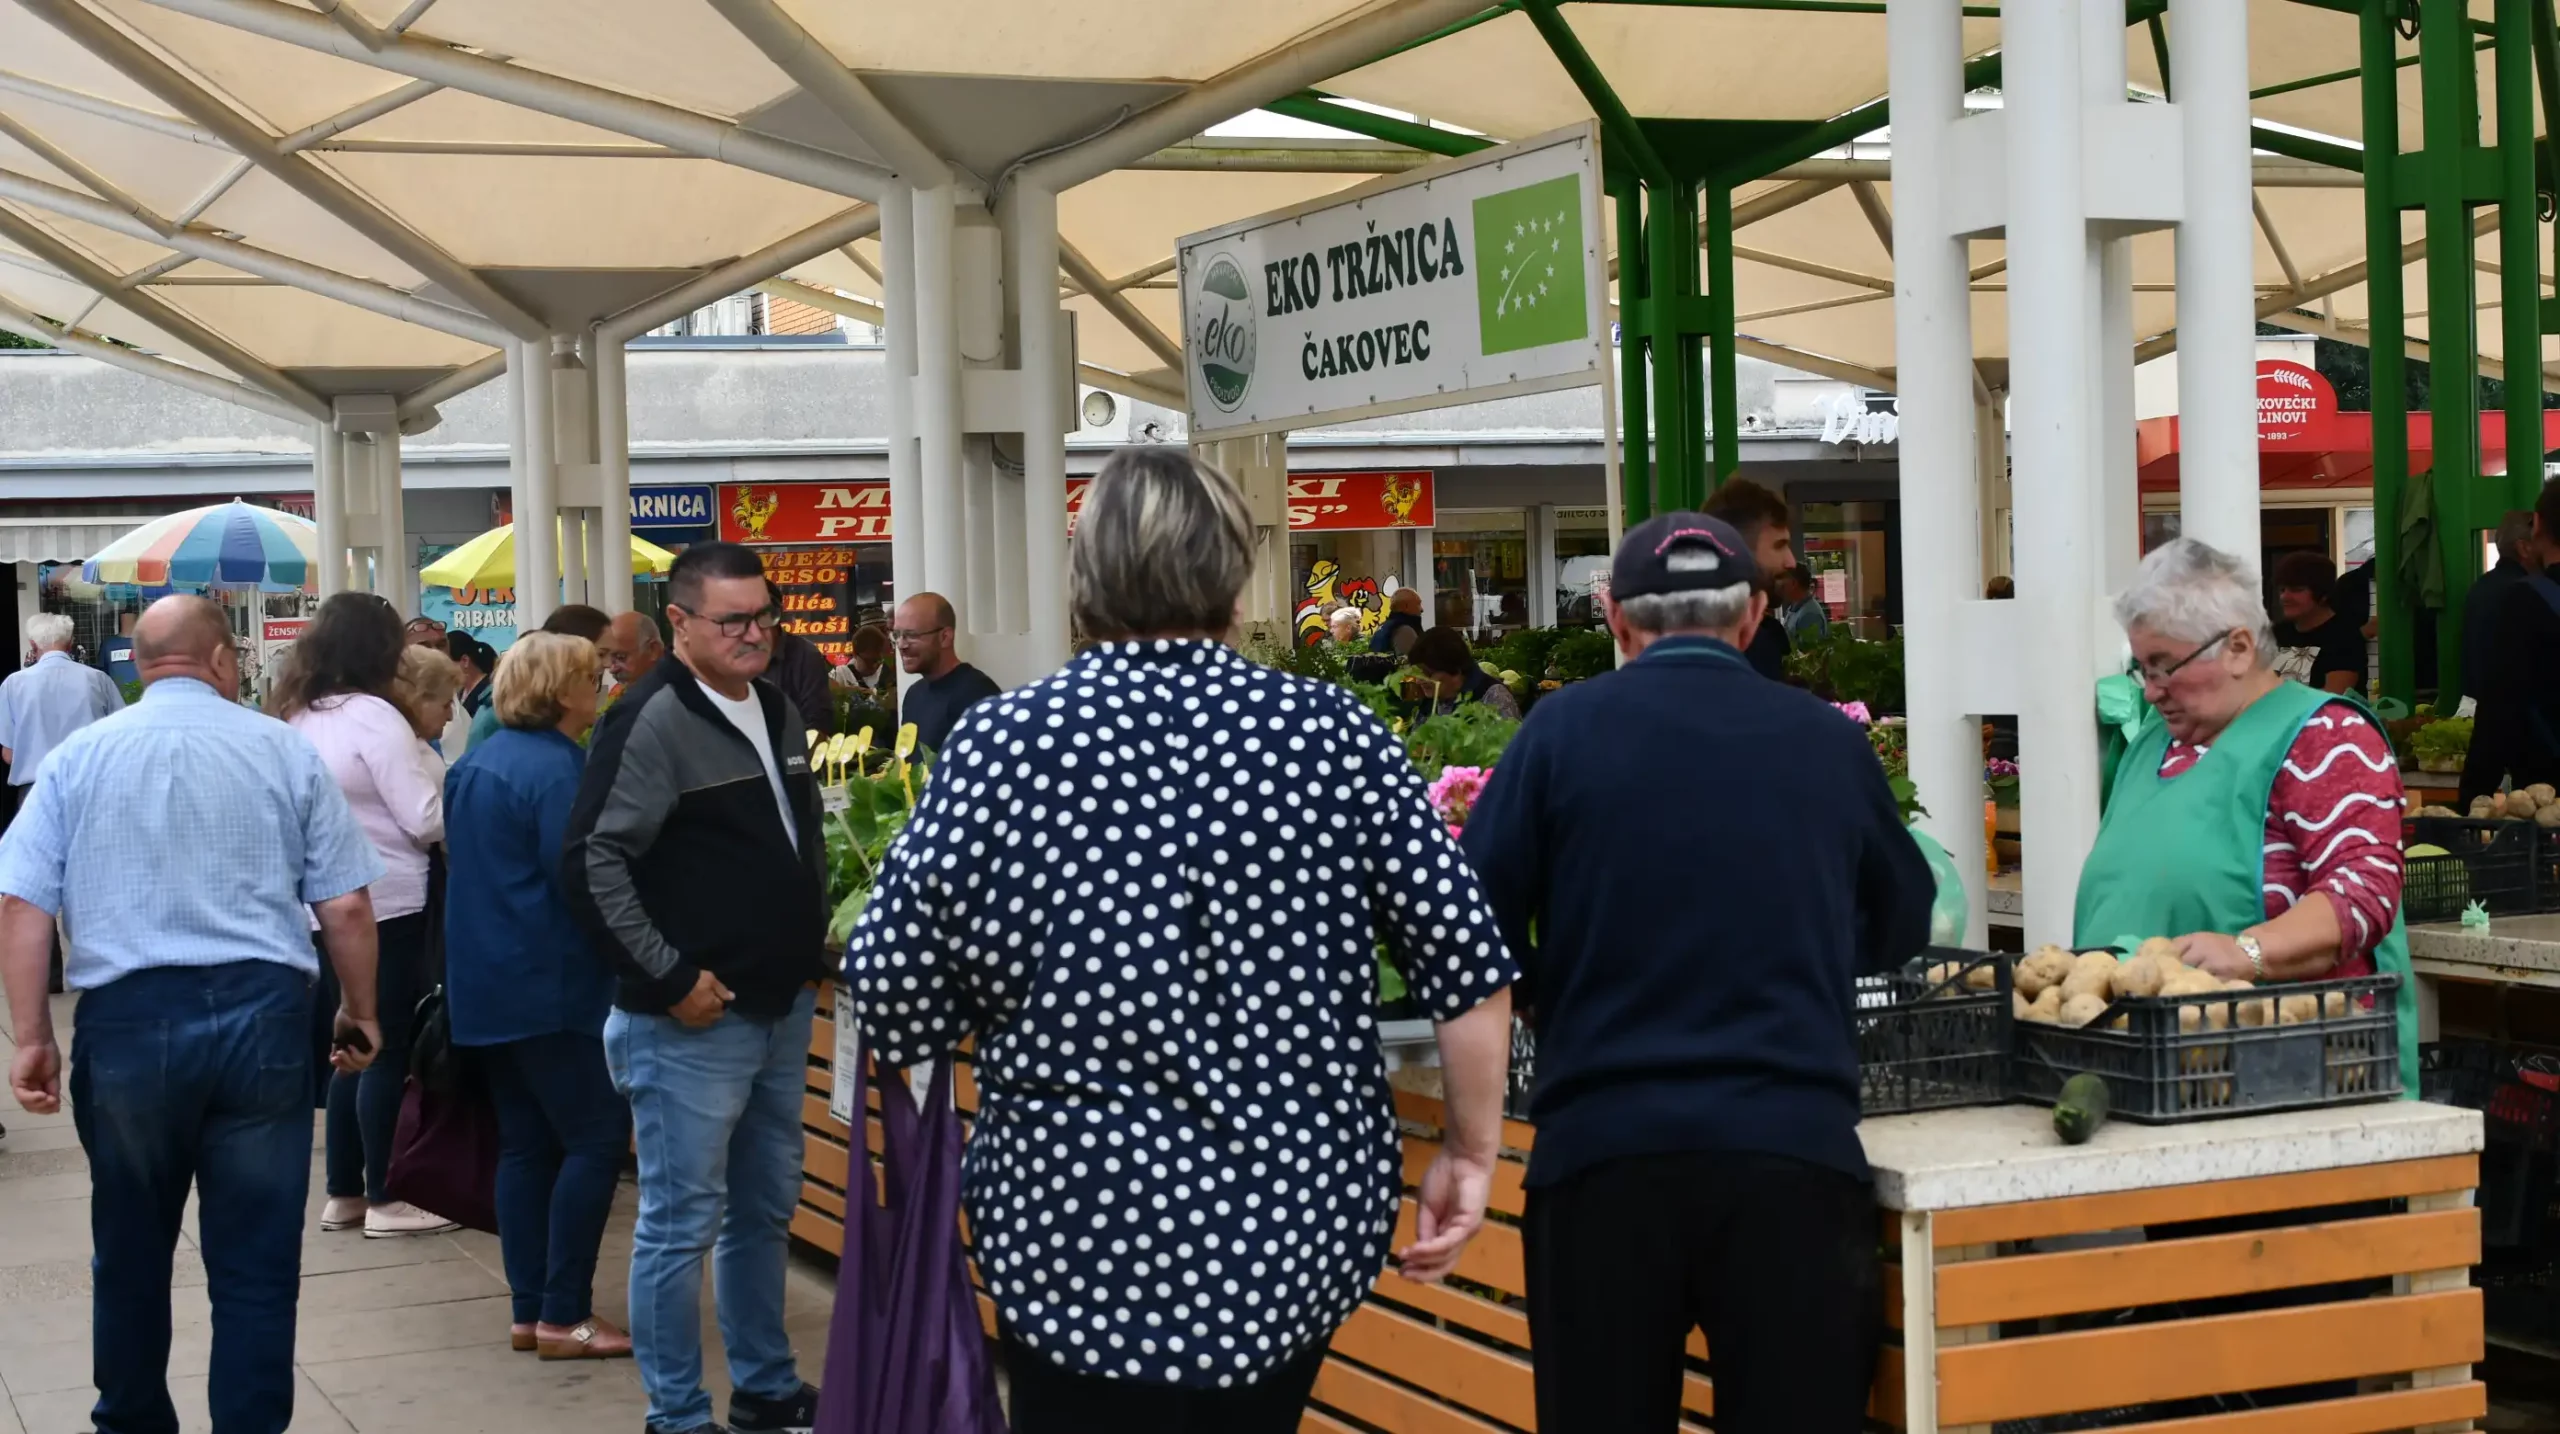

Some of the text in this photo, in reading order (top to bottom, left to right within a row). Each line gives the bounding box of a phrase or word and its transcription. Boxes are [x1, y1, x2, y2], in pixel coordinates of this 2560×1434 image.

[1264, 217, 1464, 317] EKO TRŽNICA
[1204, 302, 1245, 364] eko
[1302, 319, 1430, 381] ČAKOVEC
[2257, 411, 2307, 423] LINOVI
[2267, 432, 2287, 440] 1893
